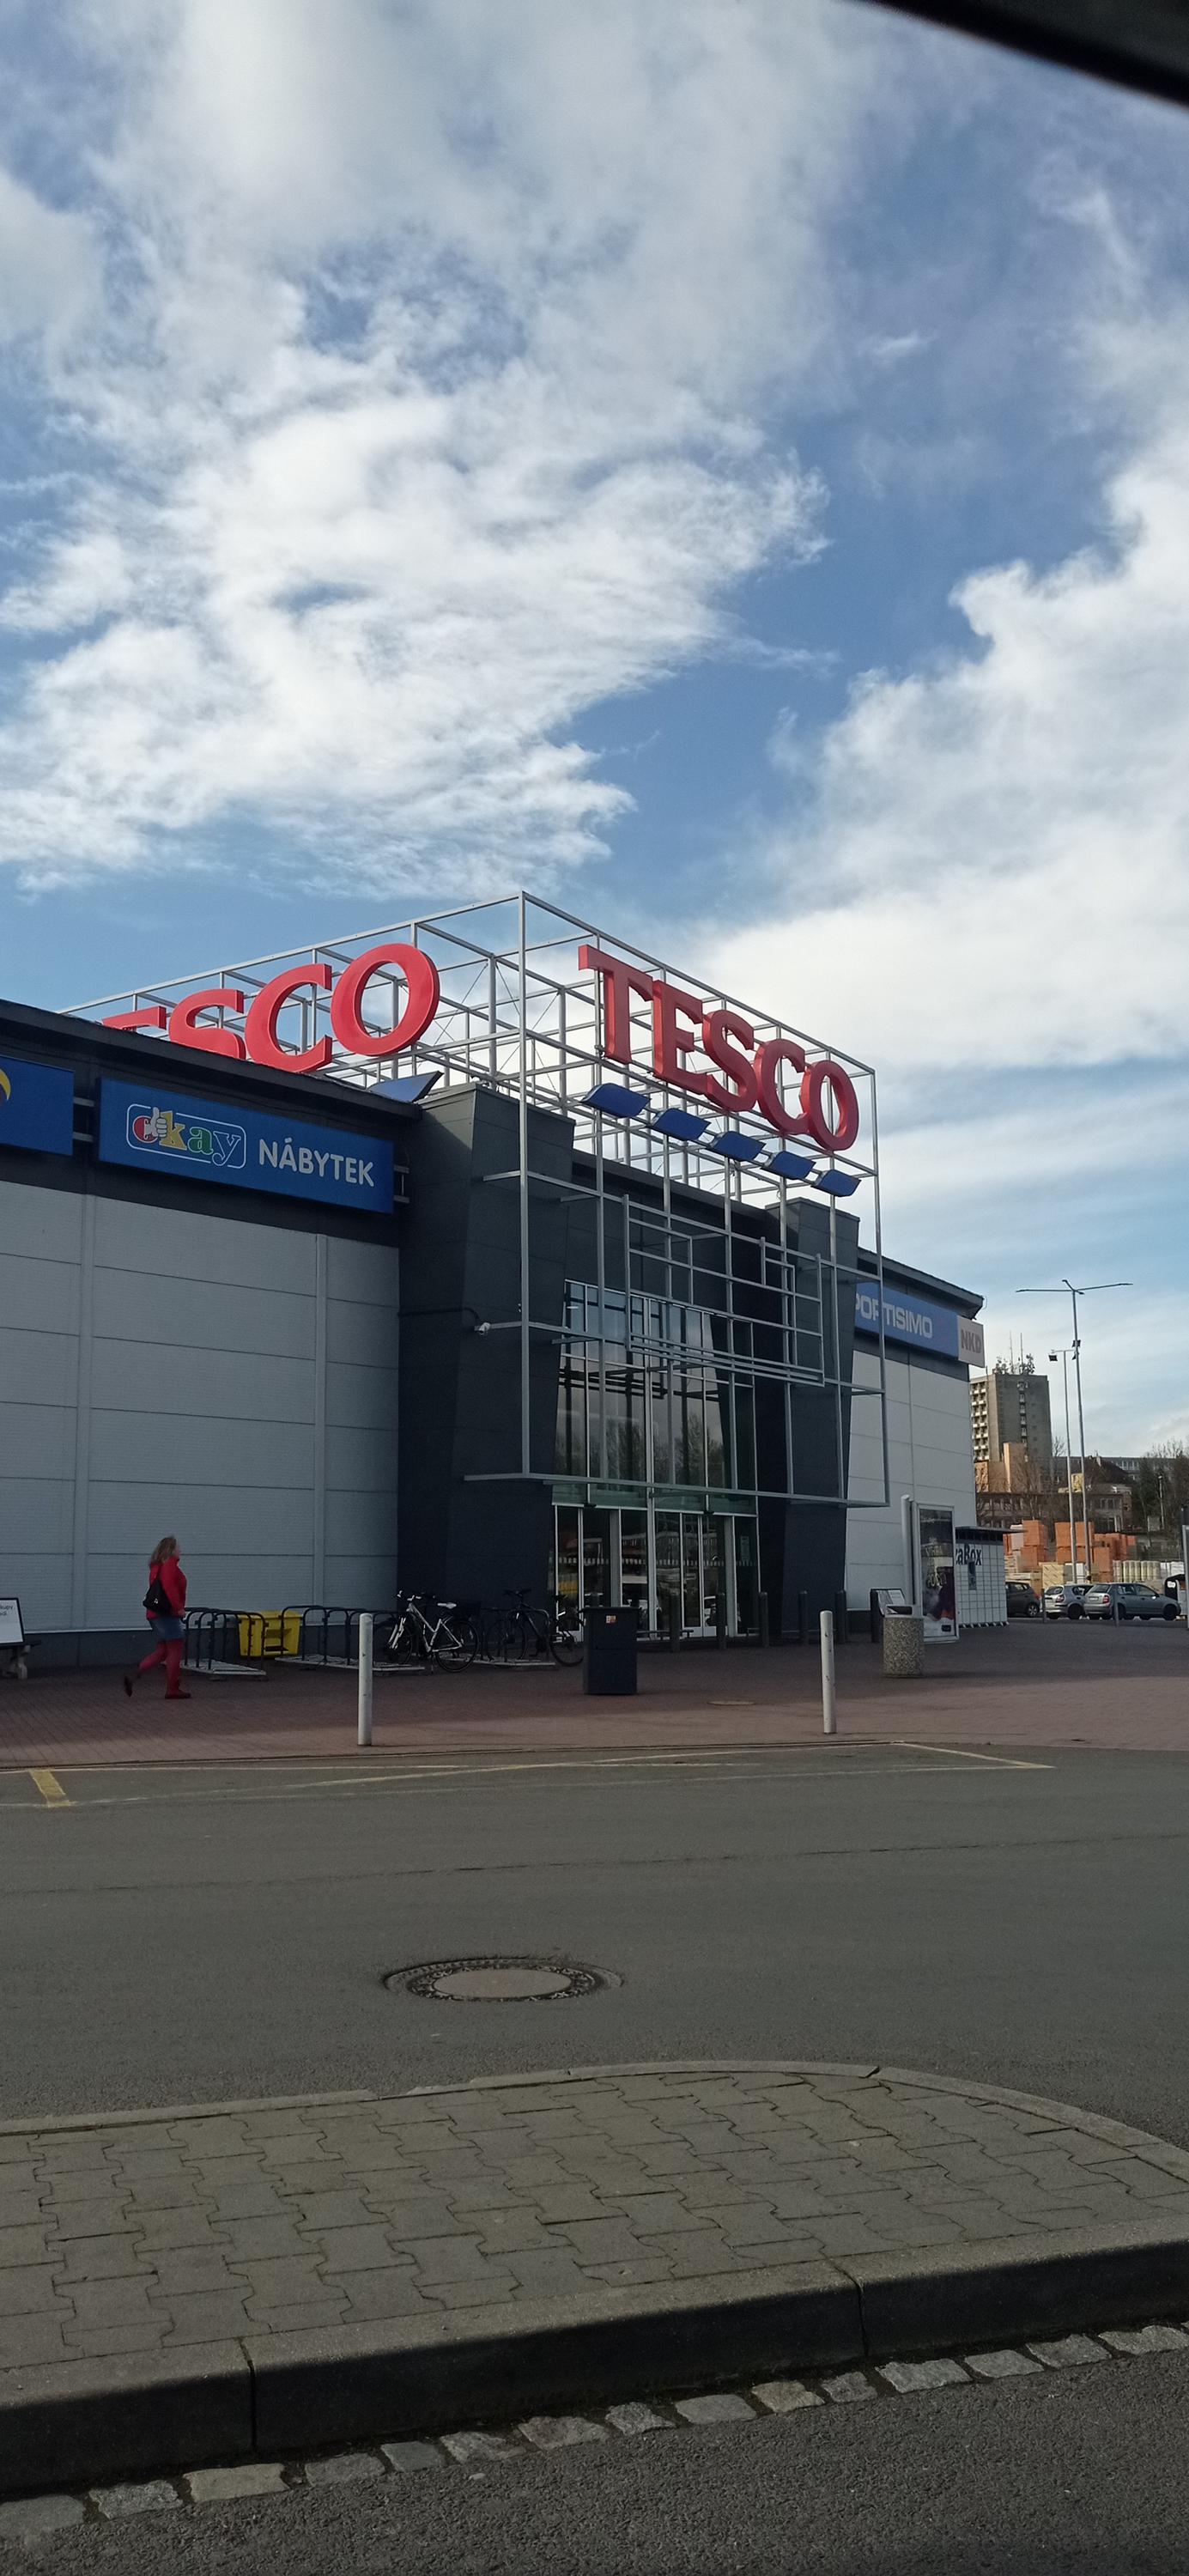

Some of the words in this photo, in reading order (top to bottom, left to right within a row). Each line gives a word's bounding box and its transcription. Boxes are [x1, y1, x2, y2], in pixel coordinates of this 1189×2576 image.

[101, 943, 440, 1073] SCO
[579, 945, 859, 1151] TESCO
[259, 1138, 374, 1187] NÁBYTEK
[961, 1329, 982, 1354] NKD
